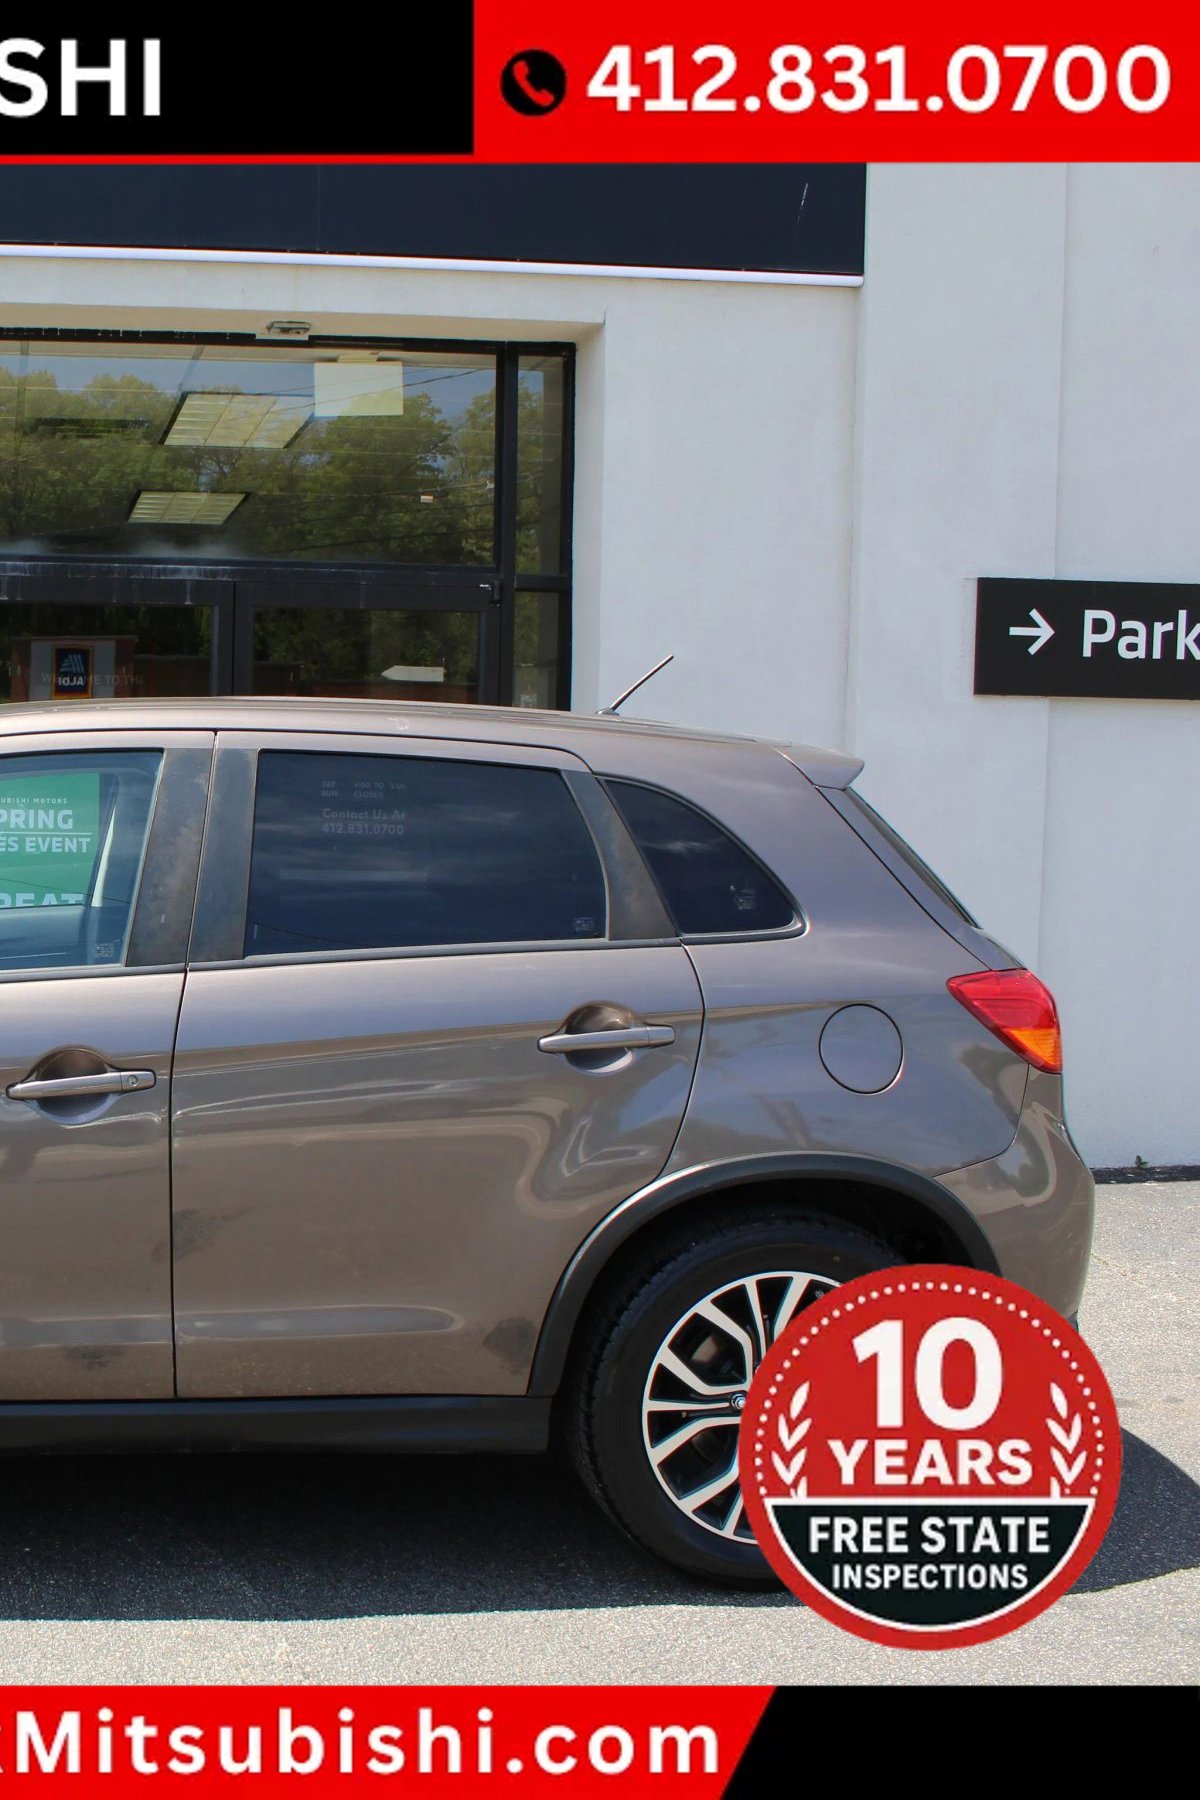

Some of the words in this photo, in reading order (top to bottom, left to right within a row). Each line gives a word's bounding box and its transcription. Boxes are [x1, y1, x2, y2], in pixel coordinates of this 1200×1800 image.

[1082, 609, 1200, 661] Park
[322, 808, 368, 820] Contact
[25, 837, 91, 853] EVENT
